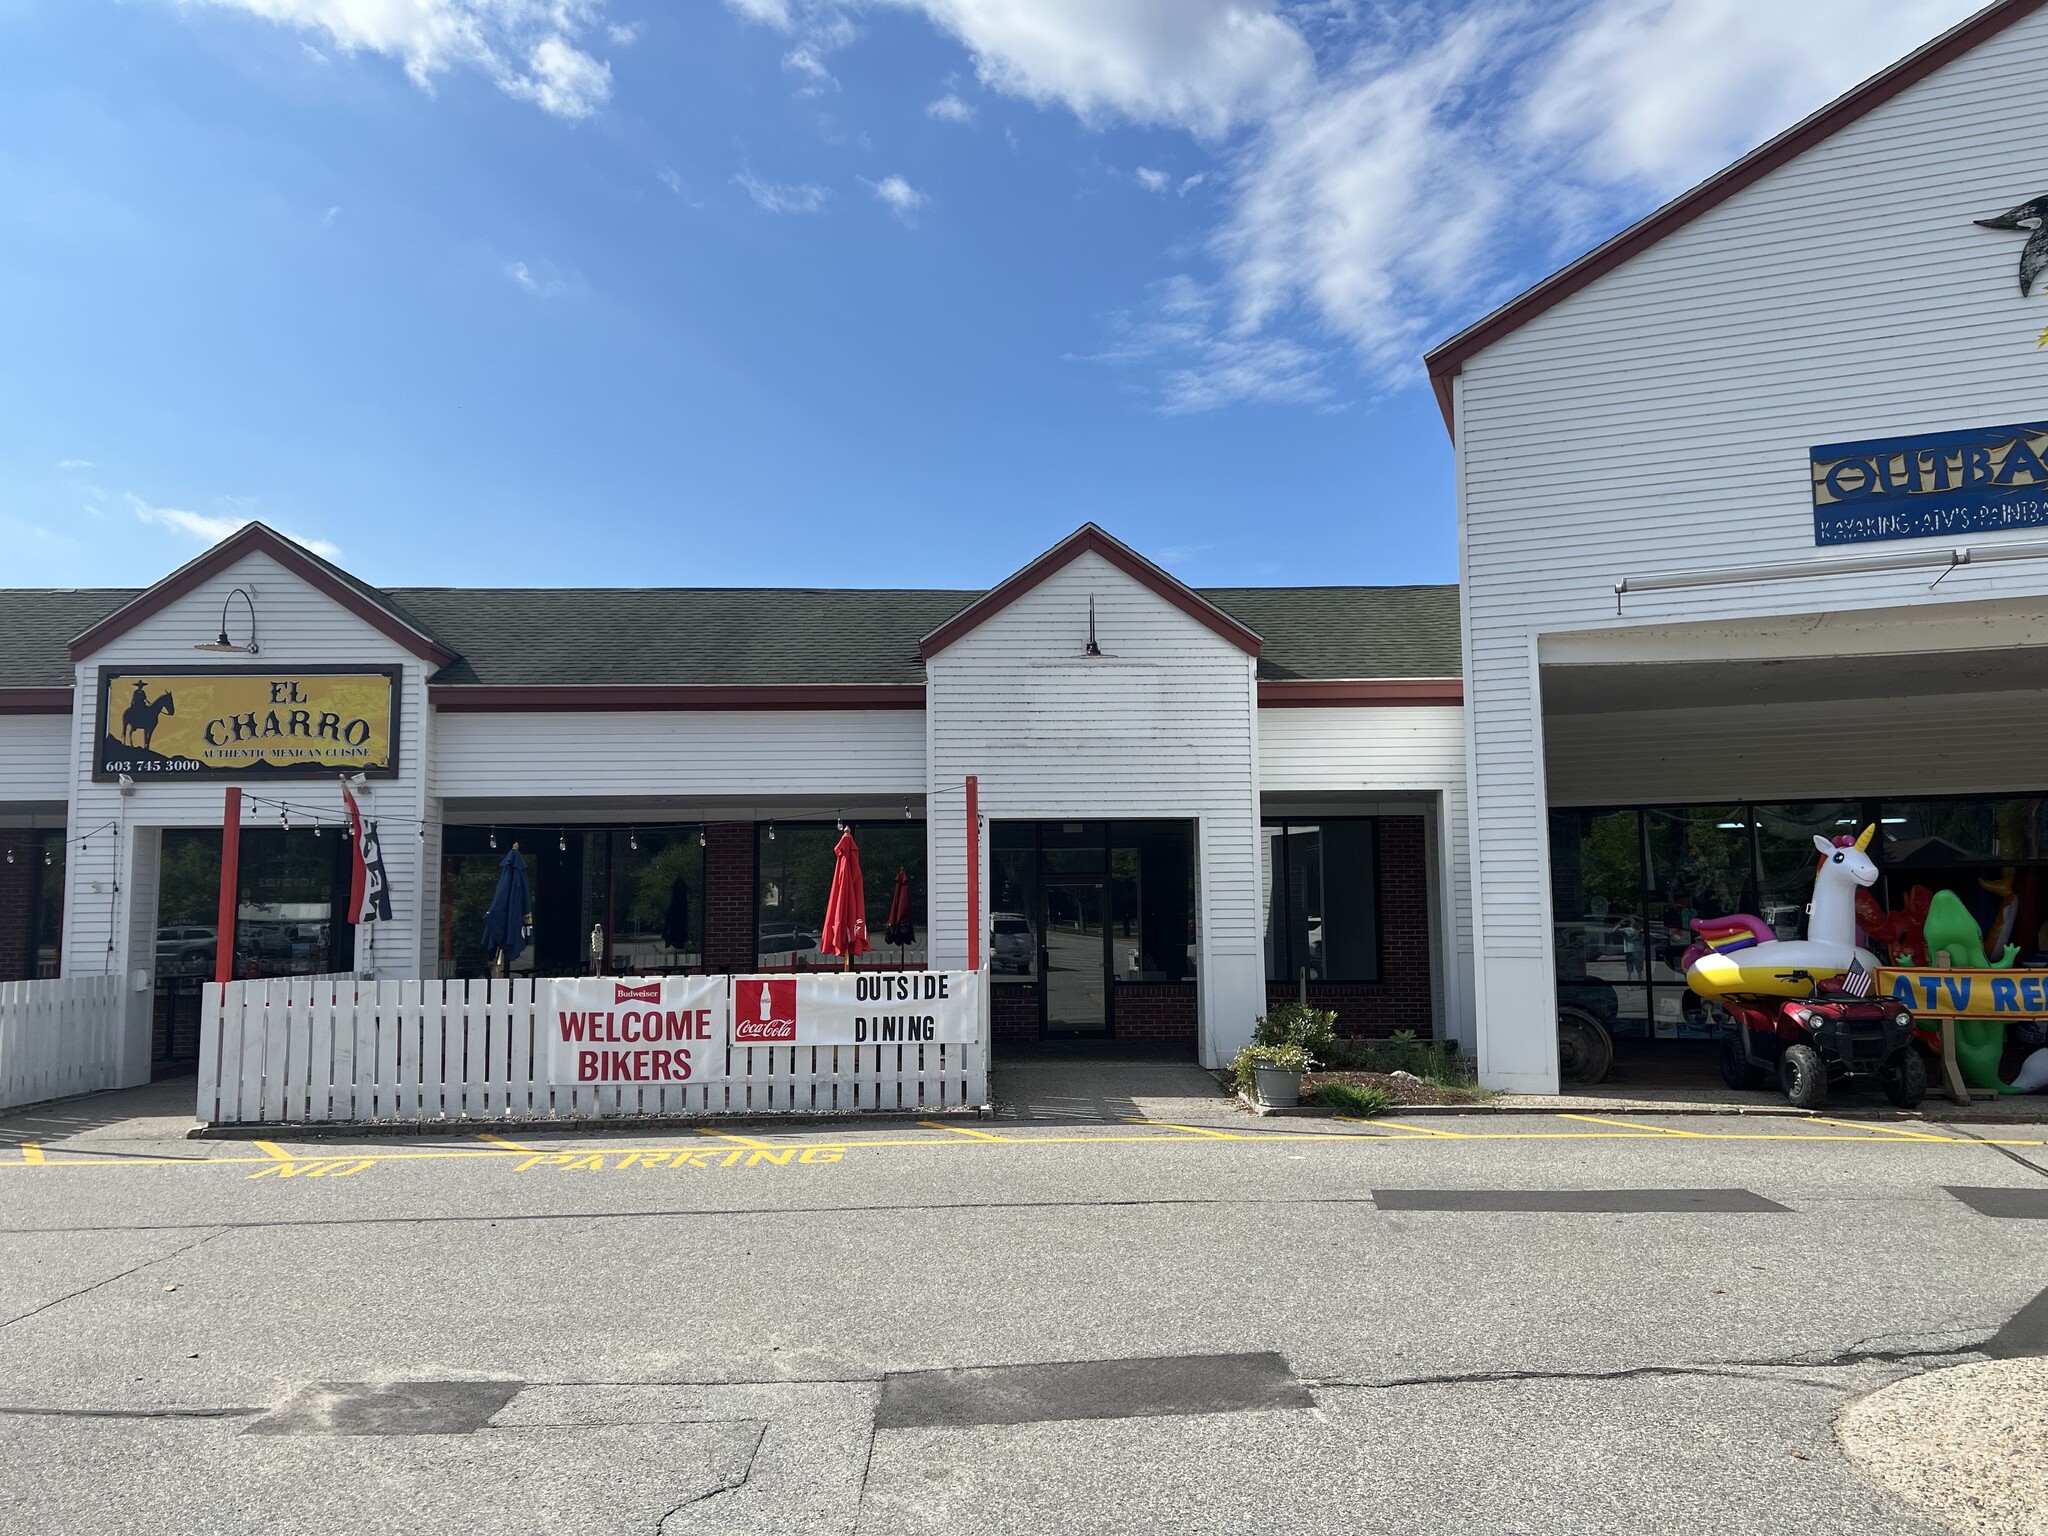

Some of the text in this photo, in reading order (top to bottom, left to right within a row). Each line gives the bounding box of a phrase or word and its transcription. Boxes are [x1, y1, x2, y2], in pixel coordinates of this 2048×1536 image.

[1820, 513, 1910, 540] KAYAKING
[270, 681, 308, 705] EL
[203, 708, 371, 747] CHARRO
[105, 760, 200, 772] 603 745 3000
[203, 748, 371, 759] AUTHENTIC MEXICAN CUISINE
[617, 989, 659, 999] Budweiser
[856, 975, 949, 1001] OUTSIDE
[1892, 975, 2048, 1012] ATV RE
[558, 1009, 712, 1043] WELCOME
[736, 1019, 795, 1038] Coca-Cola
[855, 1015, 935, 1042] DINING
[578, 1049, 692, 1082] BIKERS
[244, 1147, 847, 1179] NO PARKING
